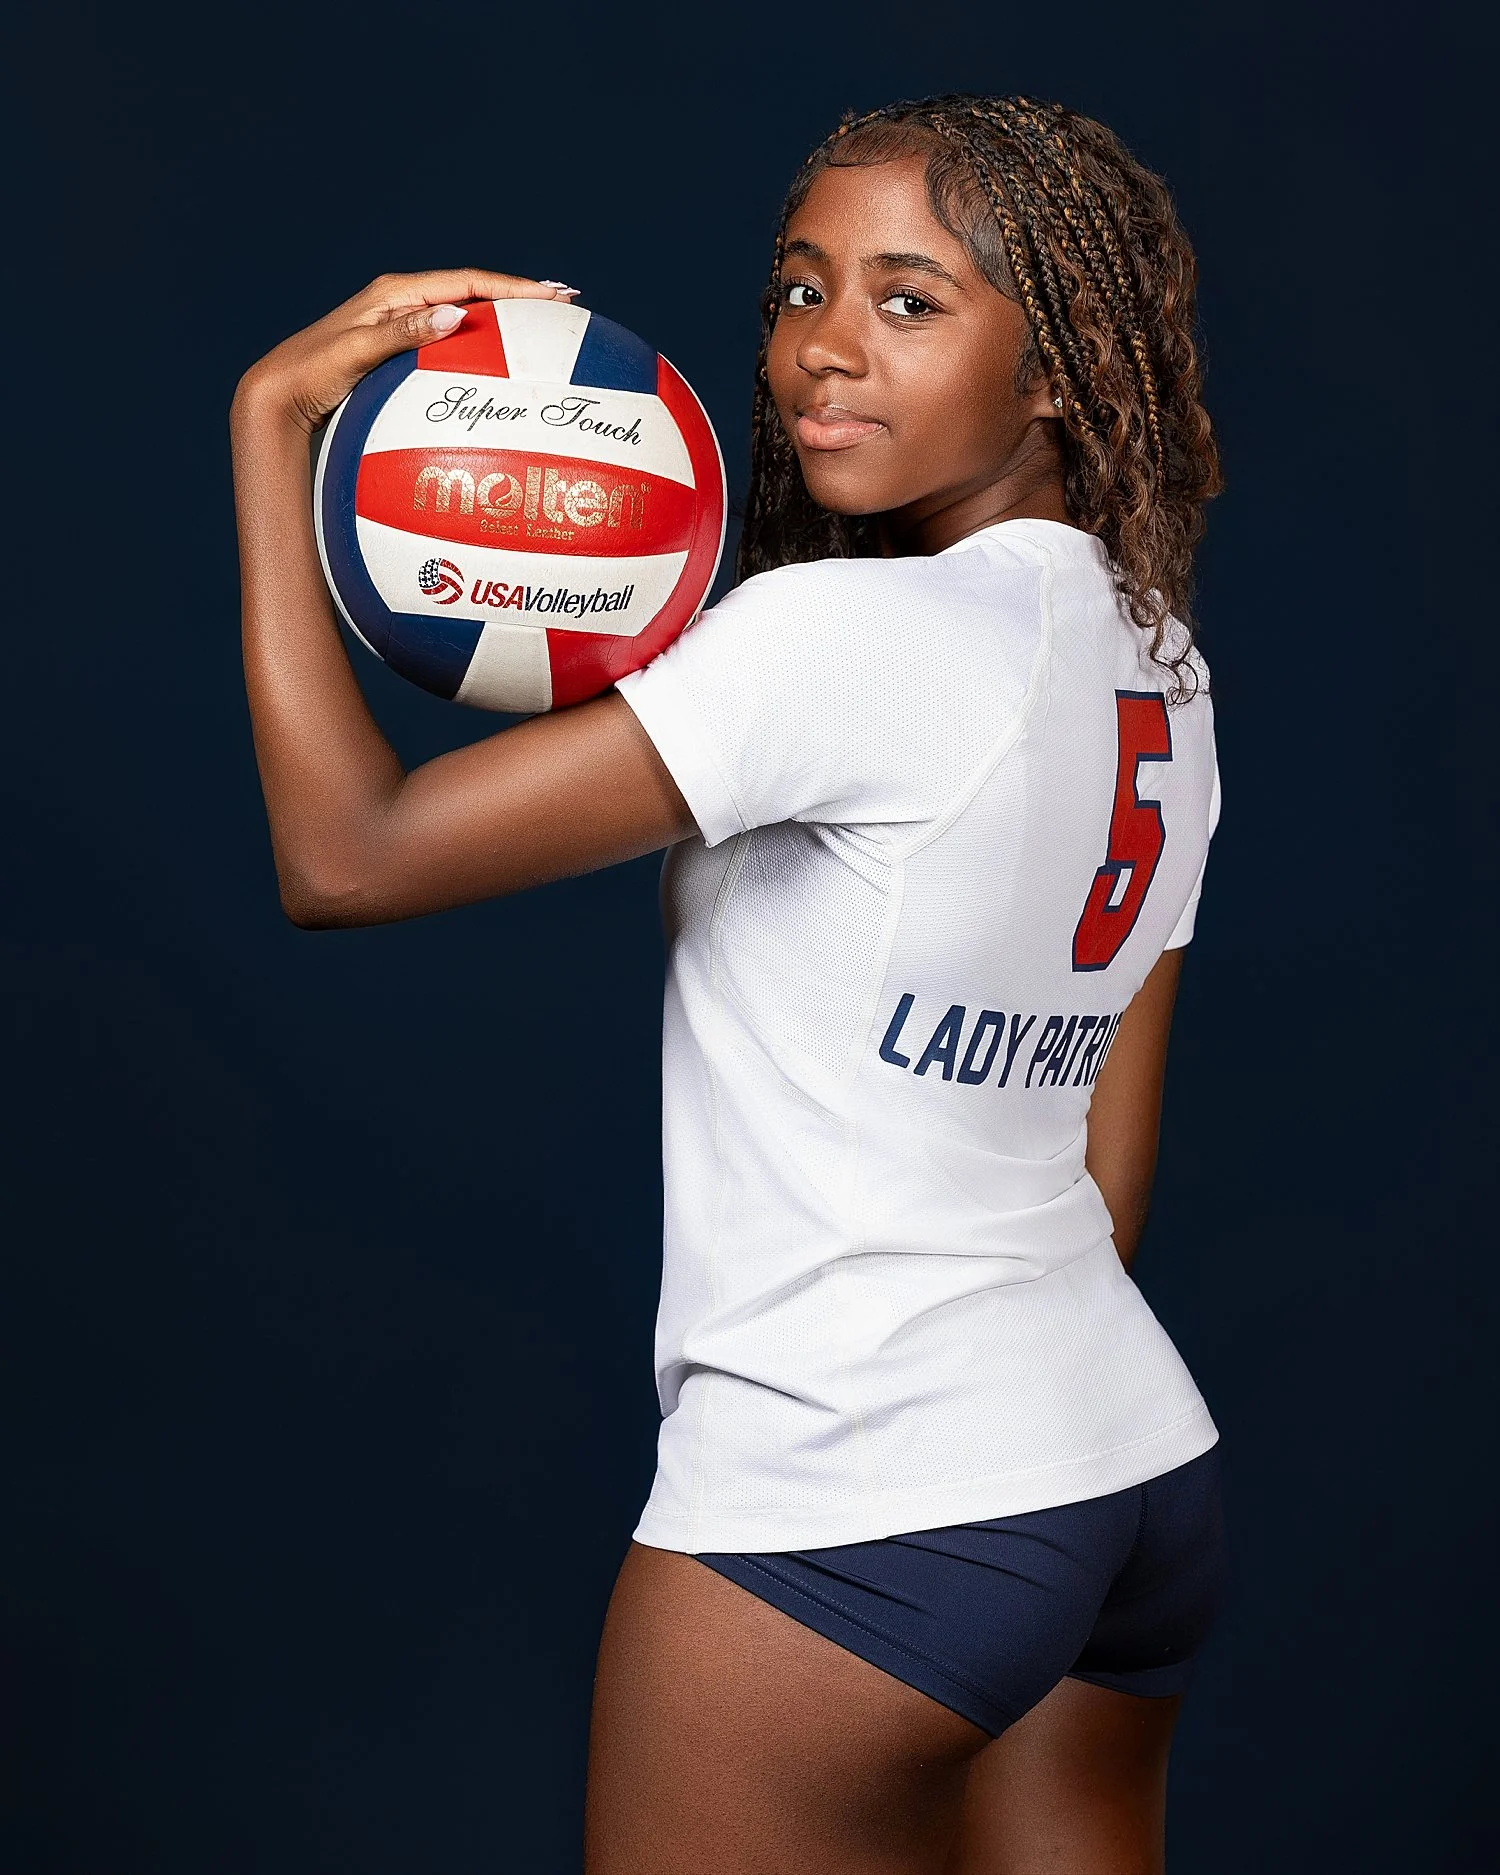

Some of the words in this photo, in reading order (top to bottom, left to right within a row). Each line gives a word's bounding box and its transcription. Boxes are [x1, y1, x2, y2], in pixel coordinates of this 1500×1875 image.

[426, 386, 528, 432] Super
[540, 397, 642, 446] Touch
[413, 466, 645, 529] molten
[480, 519, 519, 535] Select
[526, 523, 575, 541] Leather
[1072, 689, 1173, 973] 5
[878, 993, 1037, 1089] LADY
